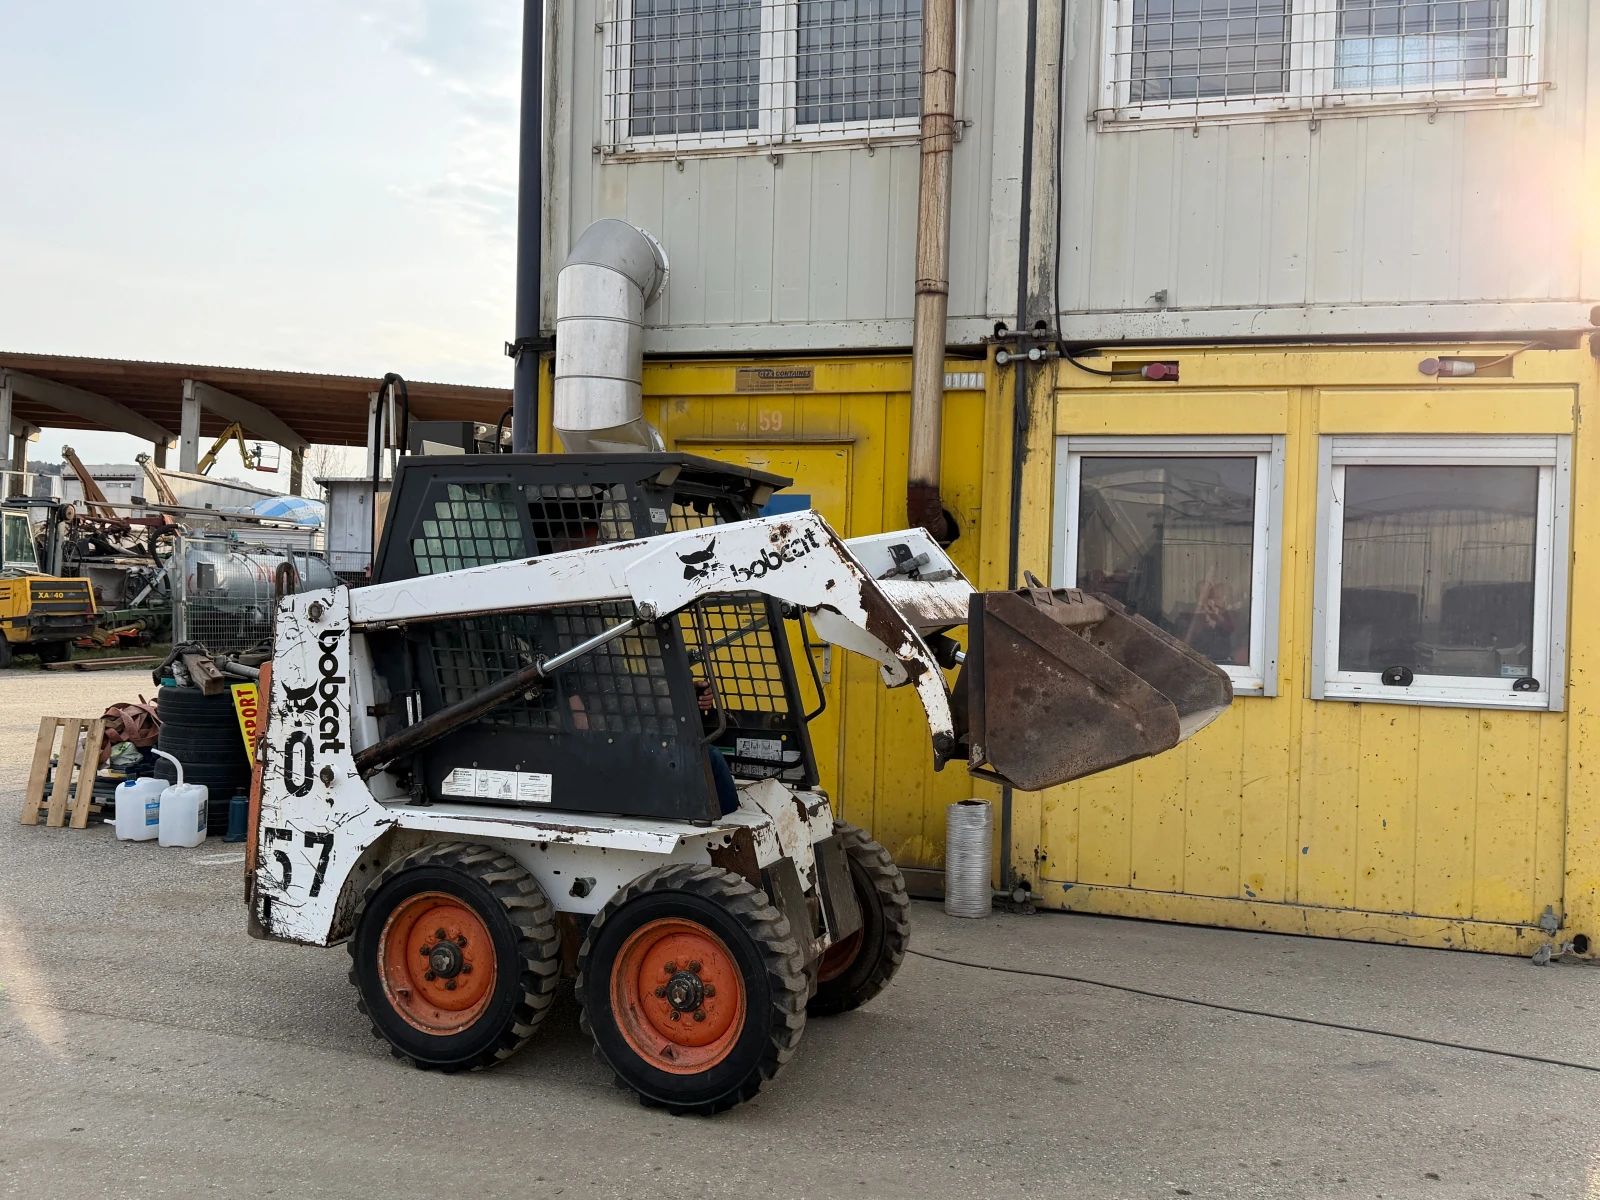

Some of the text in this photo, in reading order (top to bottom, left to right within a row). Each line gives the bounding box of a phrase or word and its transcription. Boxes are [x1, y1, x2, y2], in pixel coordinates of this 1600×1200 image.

[759, 409, 782, 431] 59
[729, 527, 820, 583] bobcat
[318, 629, 345, 754] bobcat
[264, 827, 334, 897] 57
